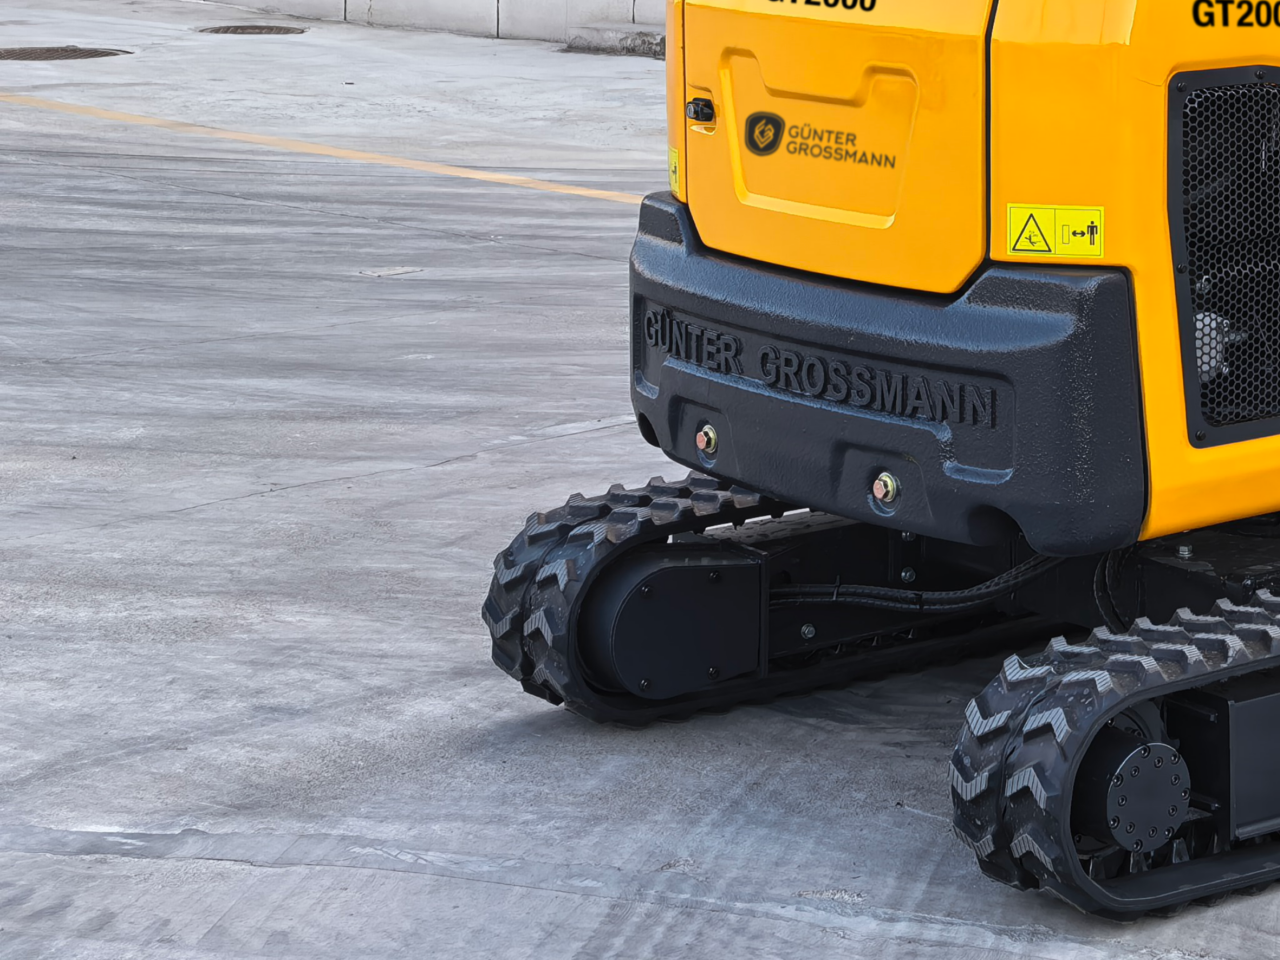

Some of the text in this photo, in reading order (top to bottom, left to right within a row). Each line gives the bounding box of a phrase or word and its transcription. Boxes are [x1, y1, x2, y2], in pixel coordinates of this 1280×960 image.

[787, 123, 857, 147] GÜNTER
[786, 140, 896, 169] GROSSMANN
[757, 343, 998, 429] GROSSMANN
